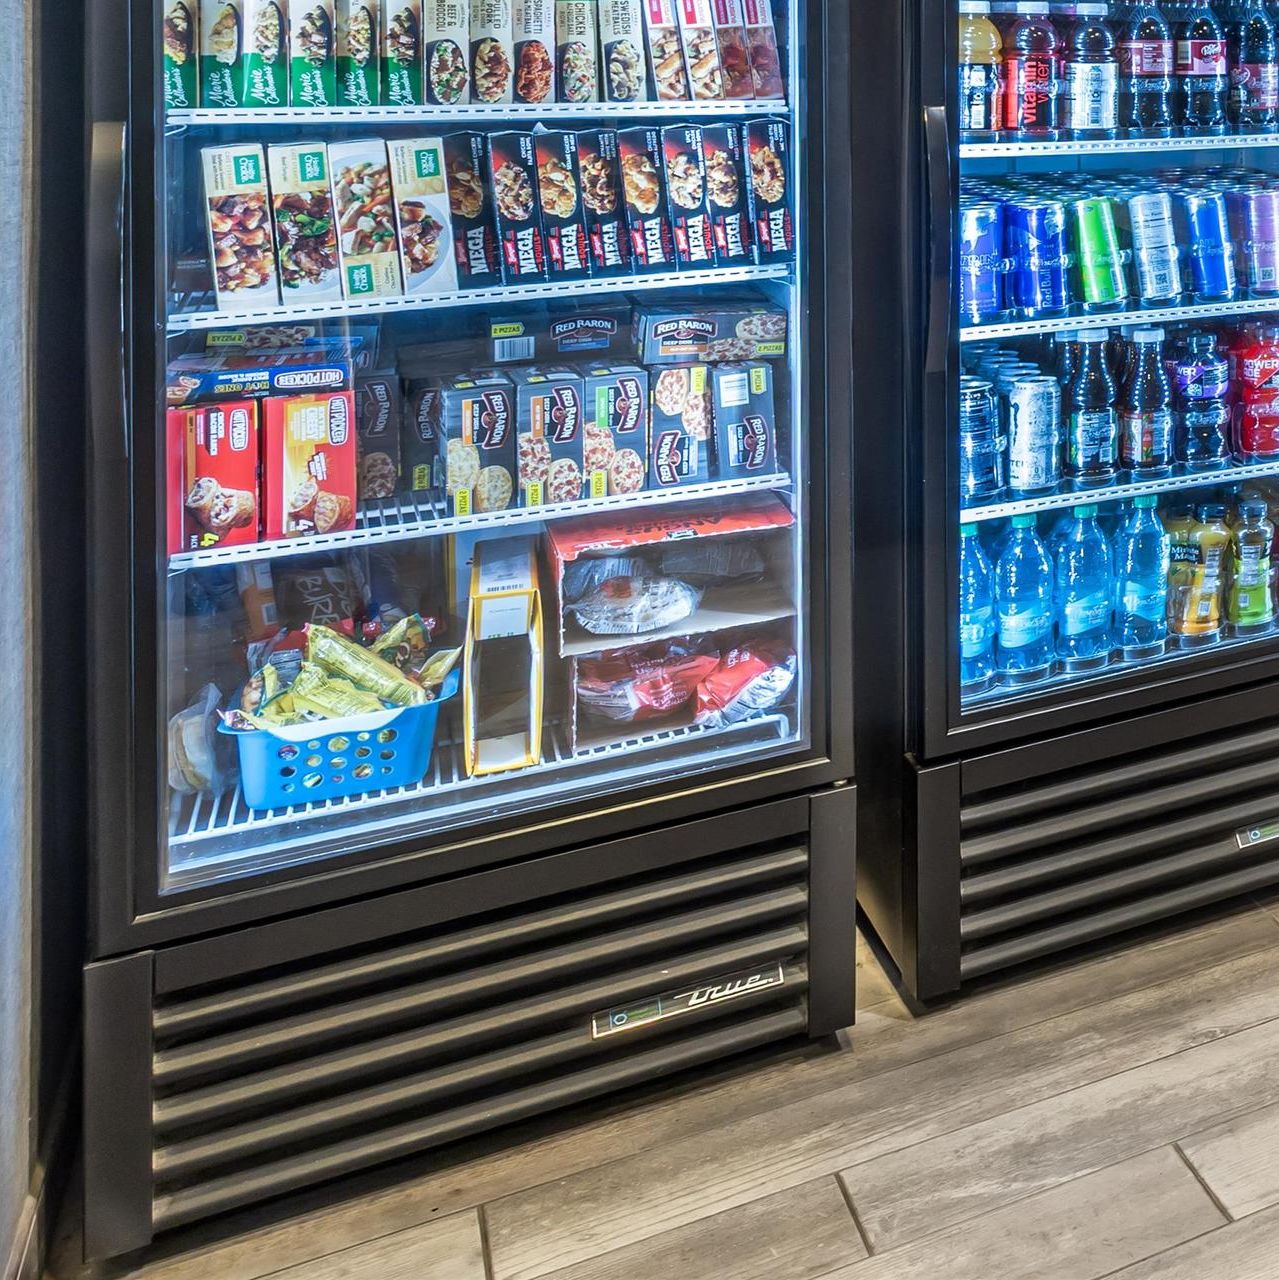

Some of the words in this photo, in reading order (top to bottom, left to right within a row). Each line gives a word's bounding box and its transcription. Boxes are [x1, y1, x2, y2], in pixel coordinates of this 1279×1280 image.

[436, 0, 446, 32] BROCCOLI
[447, 4, 456, 19] BEEF
[493, 0, 501, 29] PULLED
[533, 0, 543, 34] SPAGHETTI
[574, 2, 585, 35] CHICKEN
[611, 1, 621, 35] MEATBALLS
[620, 0, 631, 34] SWEDISH
[1024, 61, 1036, 124] vitamin
[468, 227, 490, 274] MEGA
[517, 227, 536, 273] MEGA
[533, 236, 542, 263] BOWLS
[560, 224, 580, 269] MEGA
[702, 222, 712, 250] BOWLS
[554, 321, 575, 334] RED
[576, 320, 612, 332] BARON
[657, 322, 677, 333] RED
[678, 321, 713, 333] BARON
[492, 394, 504, 412] RED
[489, 412, 504, 445] BARON
